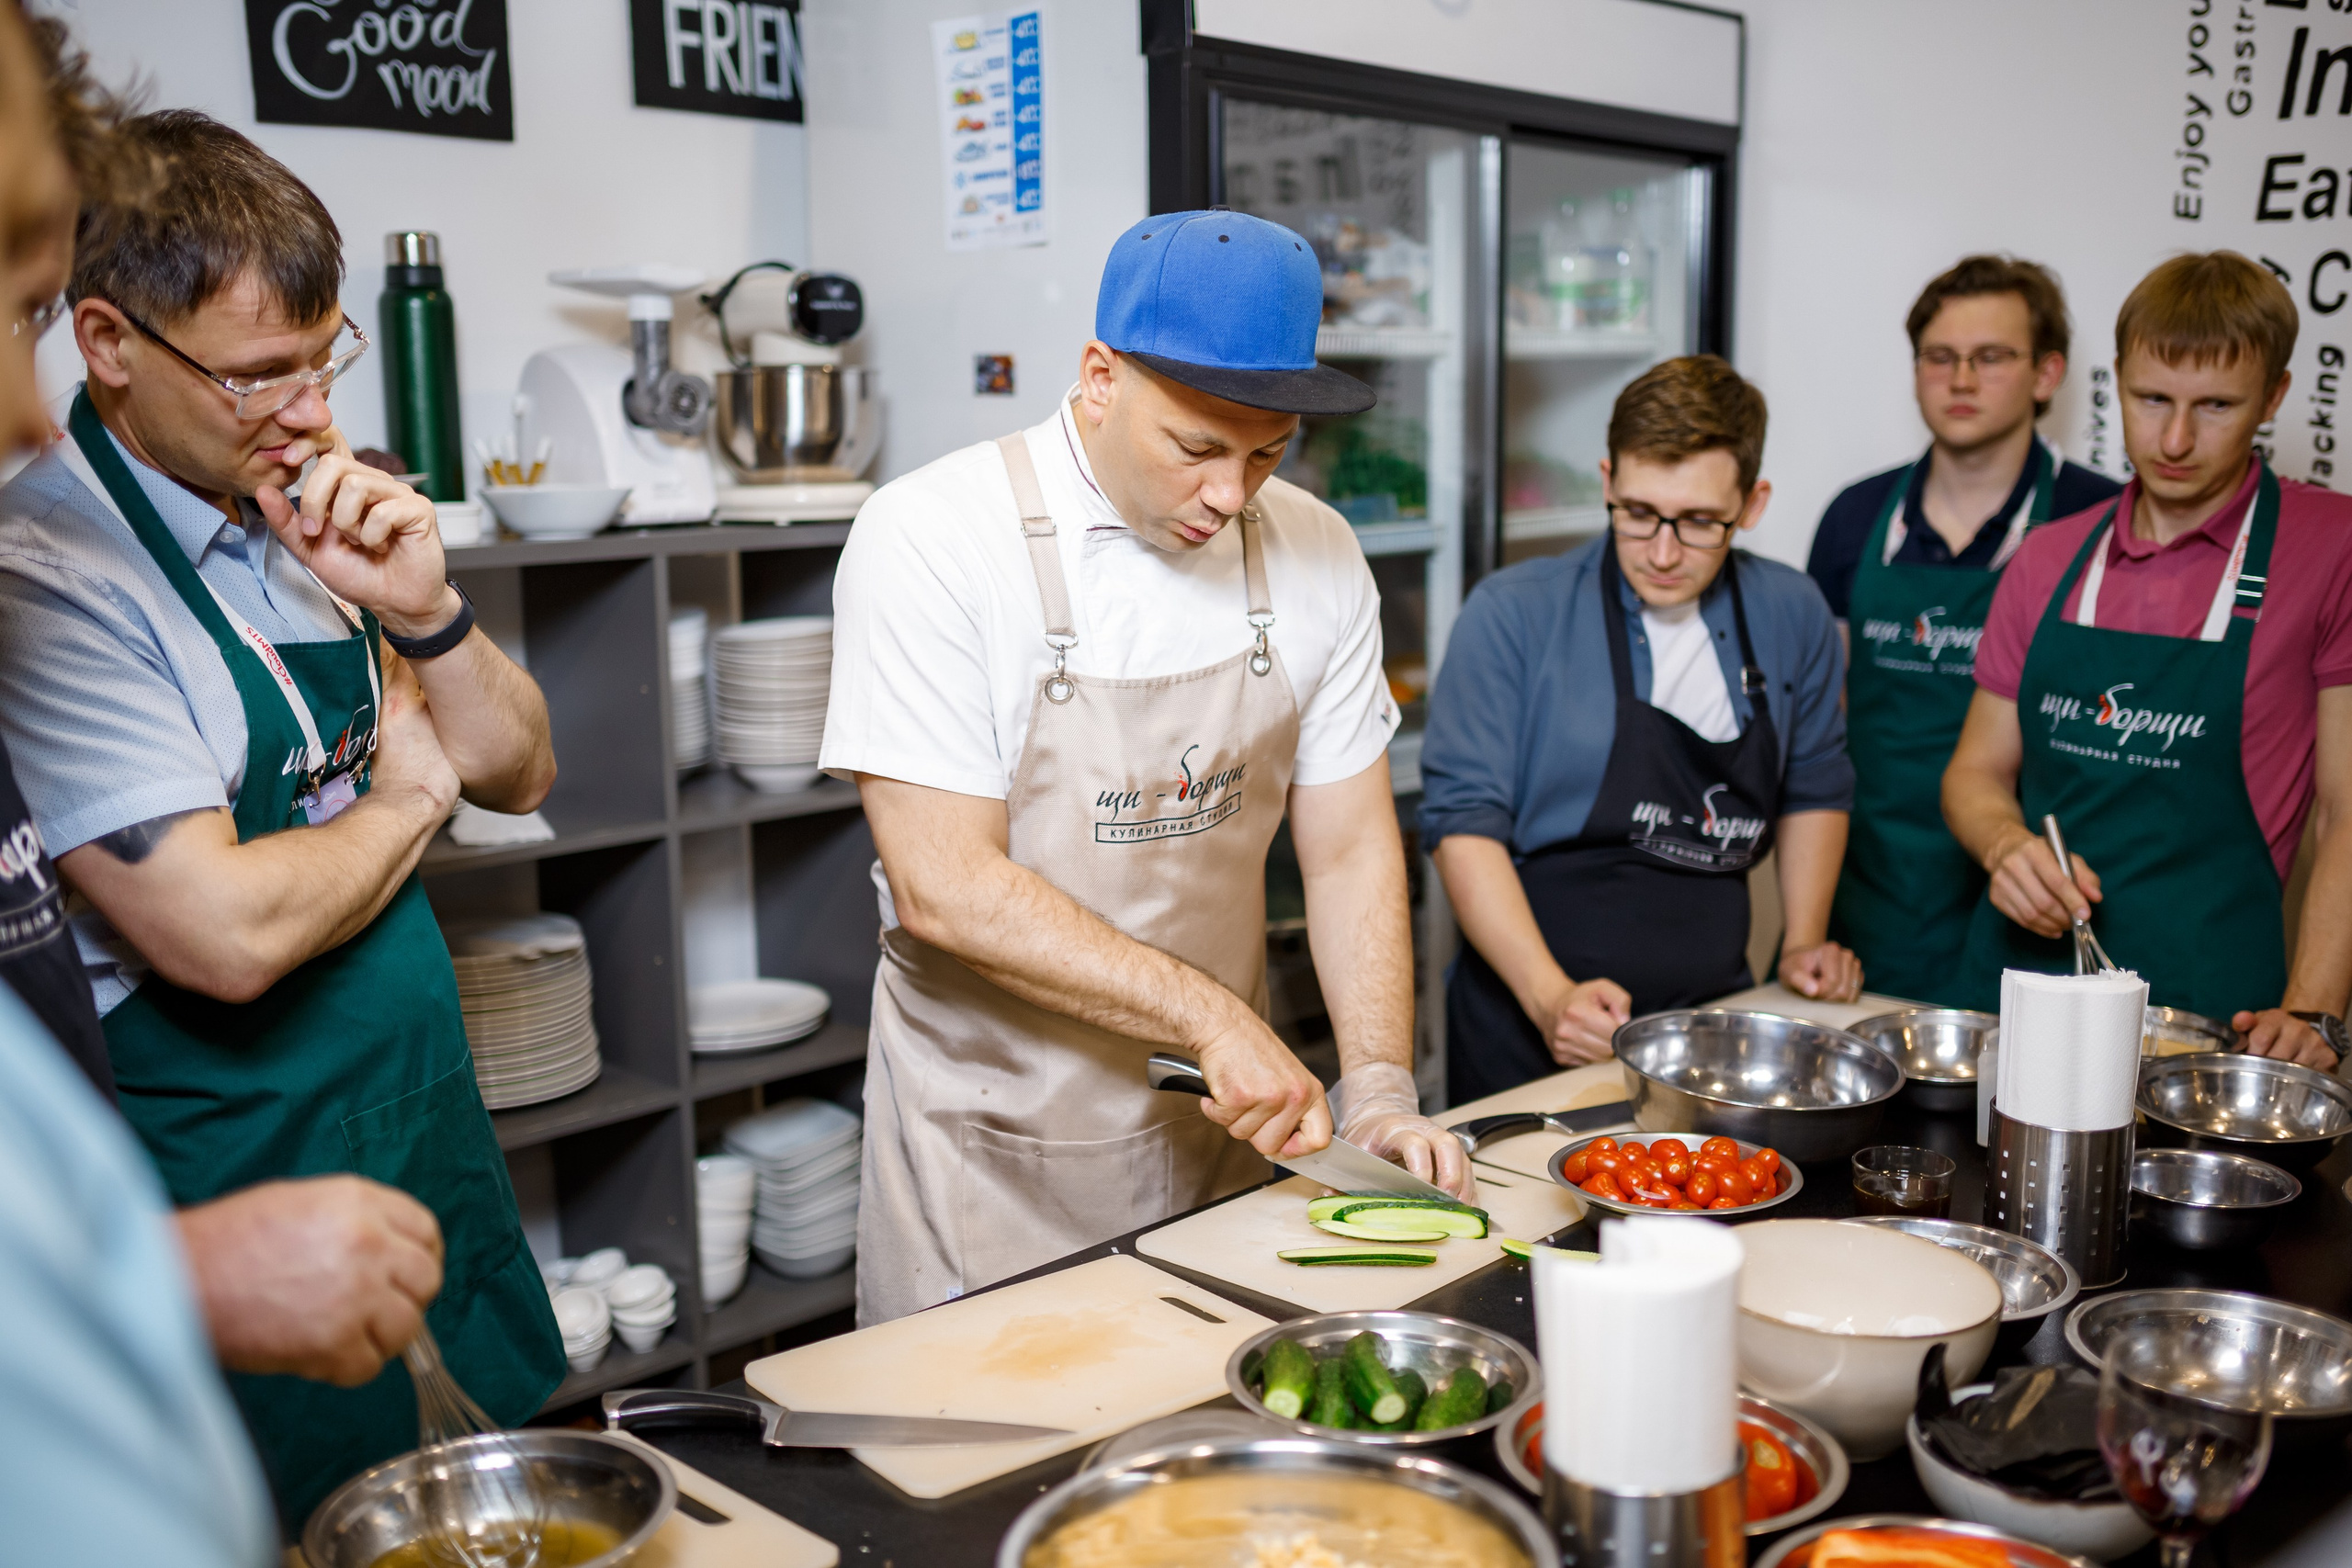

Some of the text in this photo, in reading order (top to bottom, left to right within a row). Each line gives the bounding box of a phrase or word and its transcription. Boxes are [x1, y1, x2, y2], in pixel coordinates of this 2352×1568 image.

[272, 0, 488, 100] Good
[376, 49, 497, 118] mood
[2174, 93, 2213, 220] Enjoy
[2256, 152, 2352, 221] Ea
[1110, 801, 1233, 839] КУЛИНАРНАЯ СТУДИЯ
